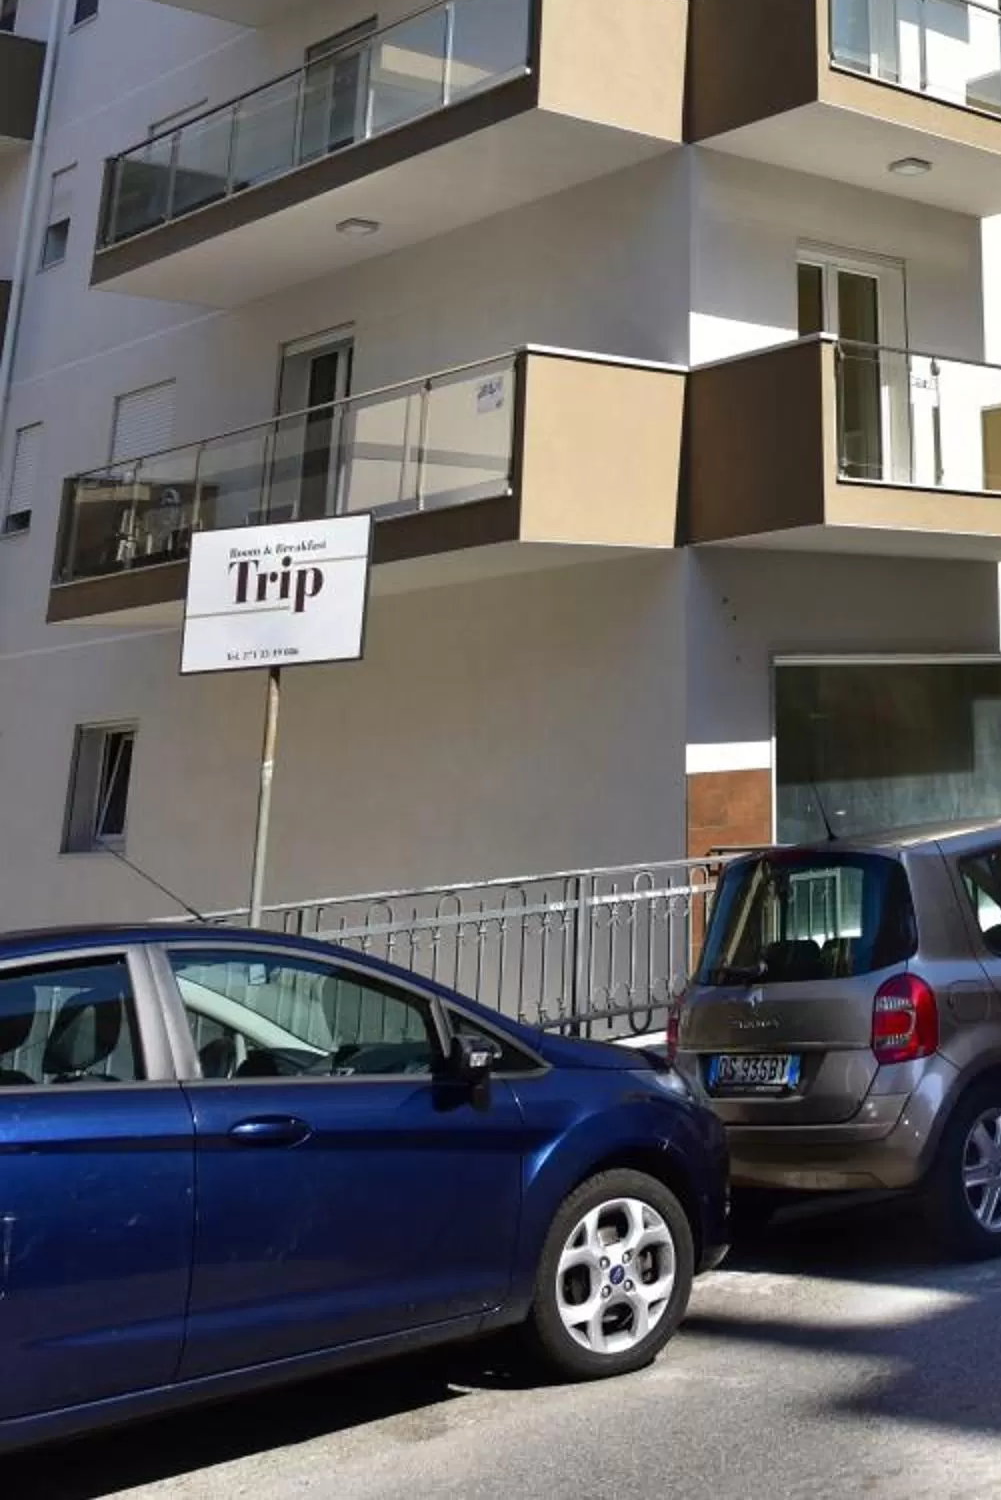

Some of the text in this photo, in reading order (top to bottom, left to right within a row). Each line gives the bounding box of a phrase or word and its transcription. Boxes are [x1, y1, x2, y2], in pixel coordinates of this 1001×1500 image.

[230, 539, 327, 559] Room & Breakfast
[228, 555, 325, 613] Trip
